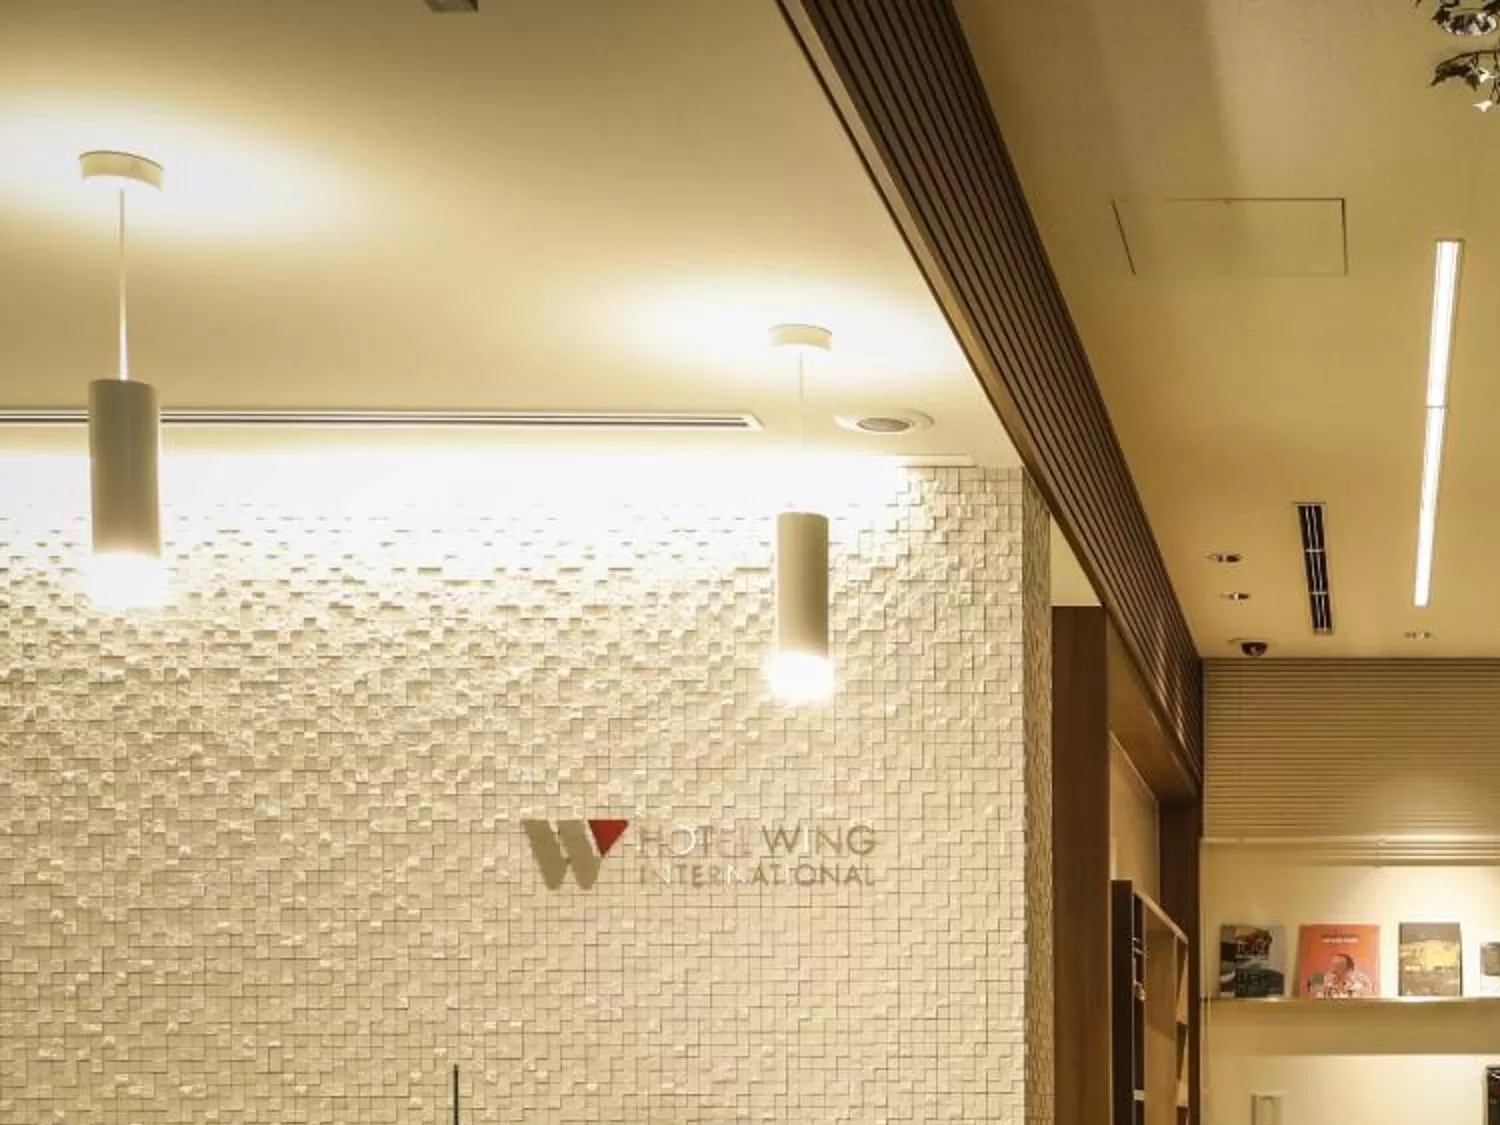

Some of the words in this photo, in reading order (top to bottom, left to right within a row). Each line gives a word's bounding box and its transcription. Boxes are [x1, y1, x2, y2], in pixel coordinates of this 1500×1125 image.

[639, 825, 752, 856] HOTEL
[762, 824, 876, 856] WING
[639, 863, 876, 887] INTERNATIONAL
